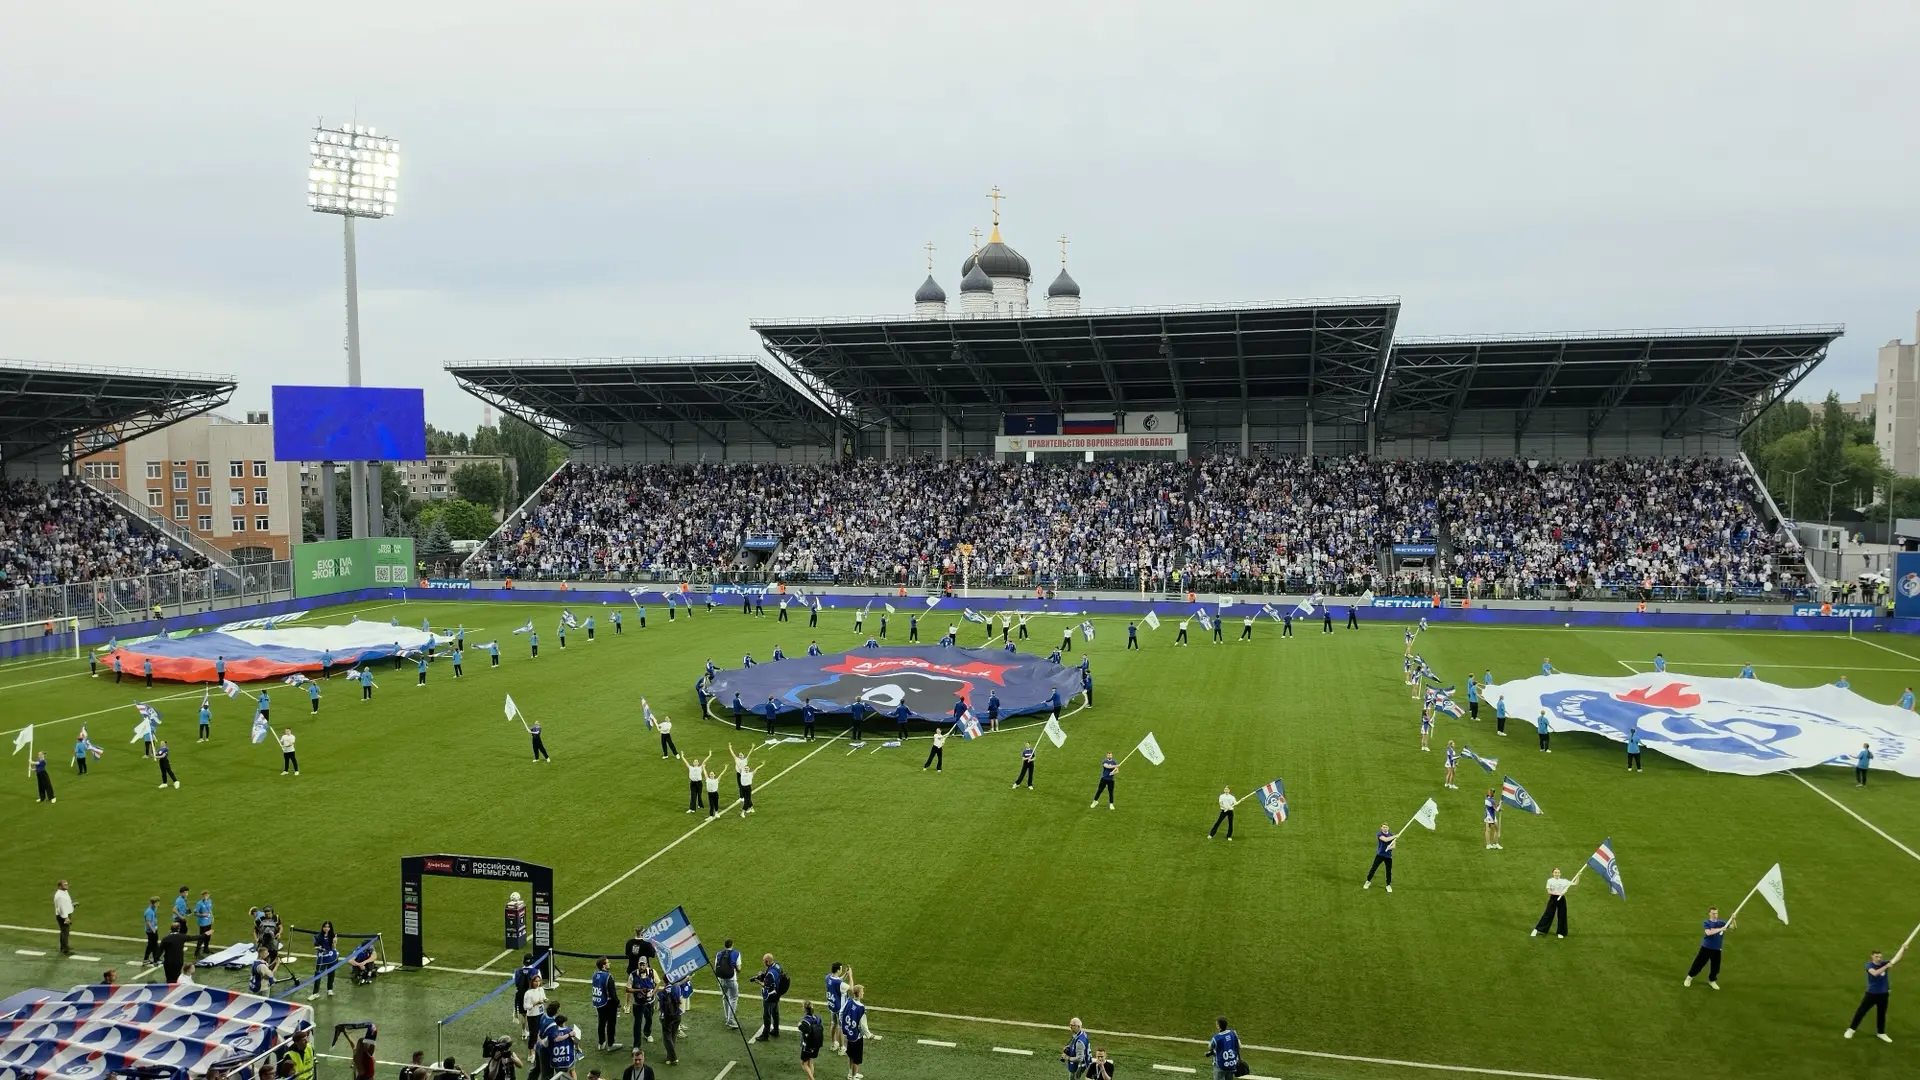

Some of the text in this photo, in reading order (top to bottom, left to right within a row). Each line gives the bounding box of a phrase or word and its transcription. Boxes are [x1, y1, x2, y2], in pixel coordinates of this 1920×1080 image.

[1027, 437, 1173, 449] ПРАВИТЕЛЬСТВО ВОРОНЕЖСКОЙ ОБЛАСТИ
[317, 557, 352, 570] EKONIVA
[312, 566, 351, 580] ЭКОНИВА
[1796, 608, 1872, 617] БЕСИТИ
[472, 862, 521, 872] РОССИЙСКАЯ
[472, 868, 529, 878] ПРЕМЬЕР-ЛИГА
[553, 1045, 570, 1056] 021
